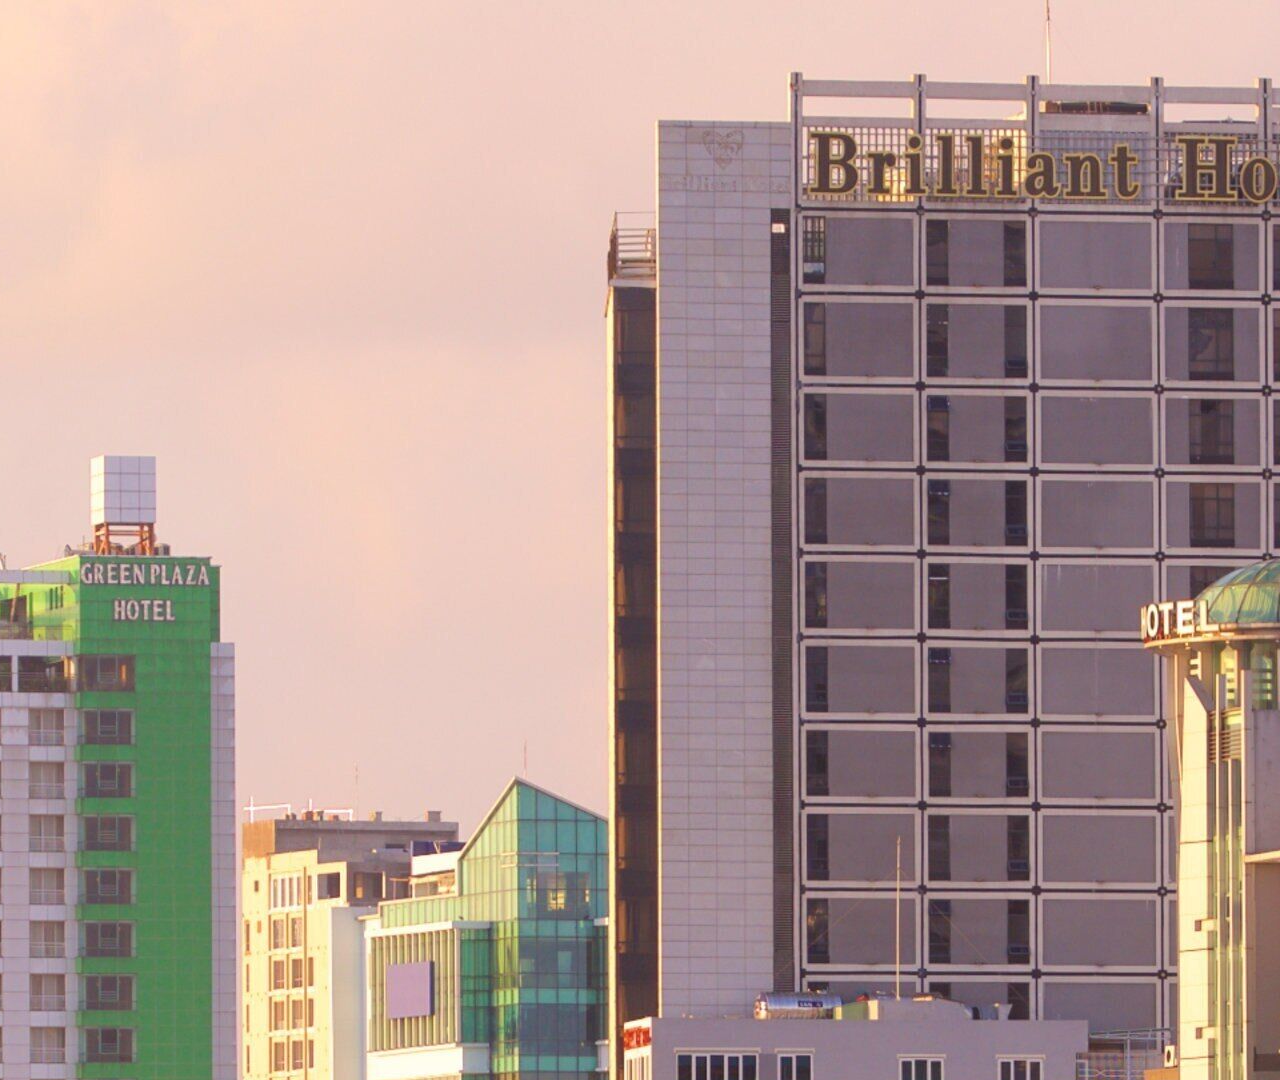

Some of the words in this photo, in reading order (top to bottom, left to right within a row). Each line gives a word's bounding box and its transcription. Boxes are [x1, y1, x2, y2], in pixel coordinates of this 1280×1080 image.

[808, 130, 1140, 198] Brilliant
[80, 563, 145, 585] GREEN
[151, 564, 210, 585] PLAZA
[114, 600, 176, 621] HOTEL
[1141, 600, 1219, 639] HOTEL
